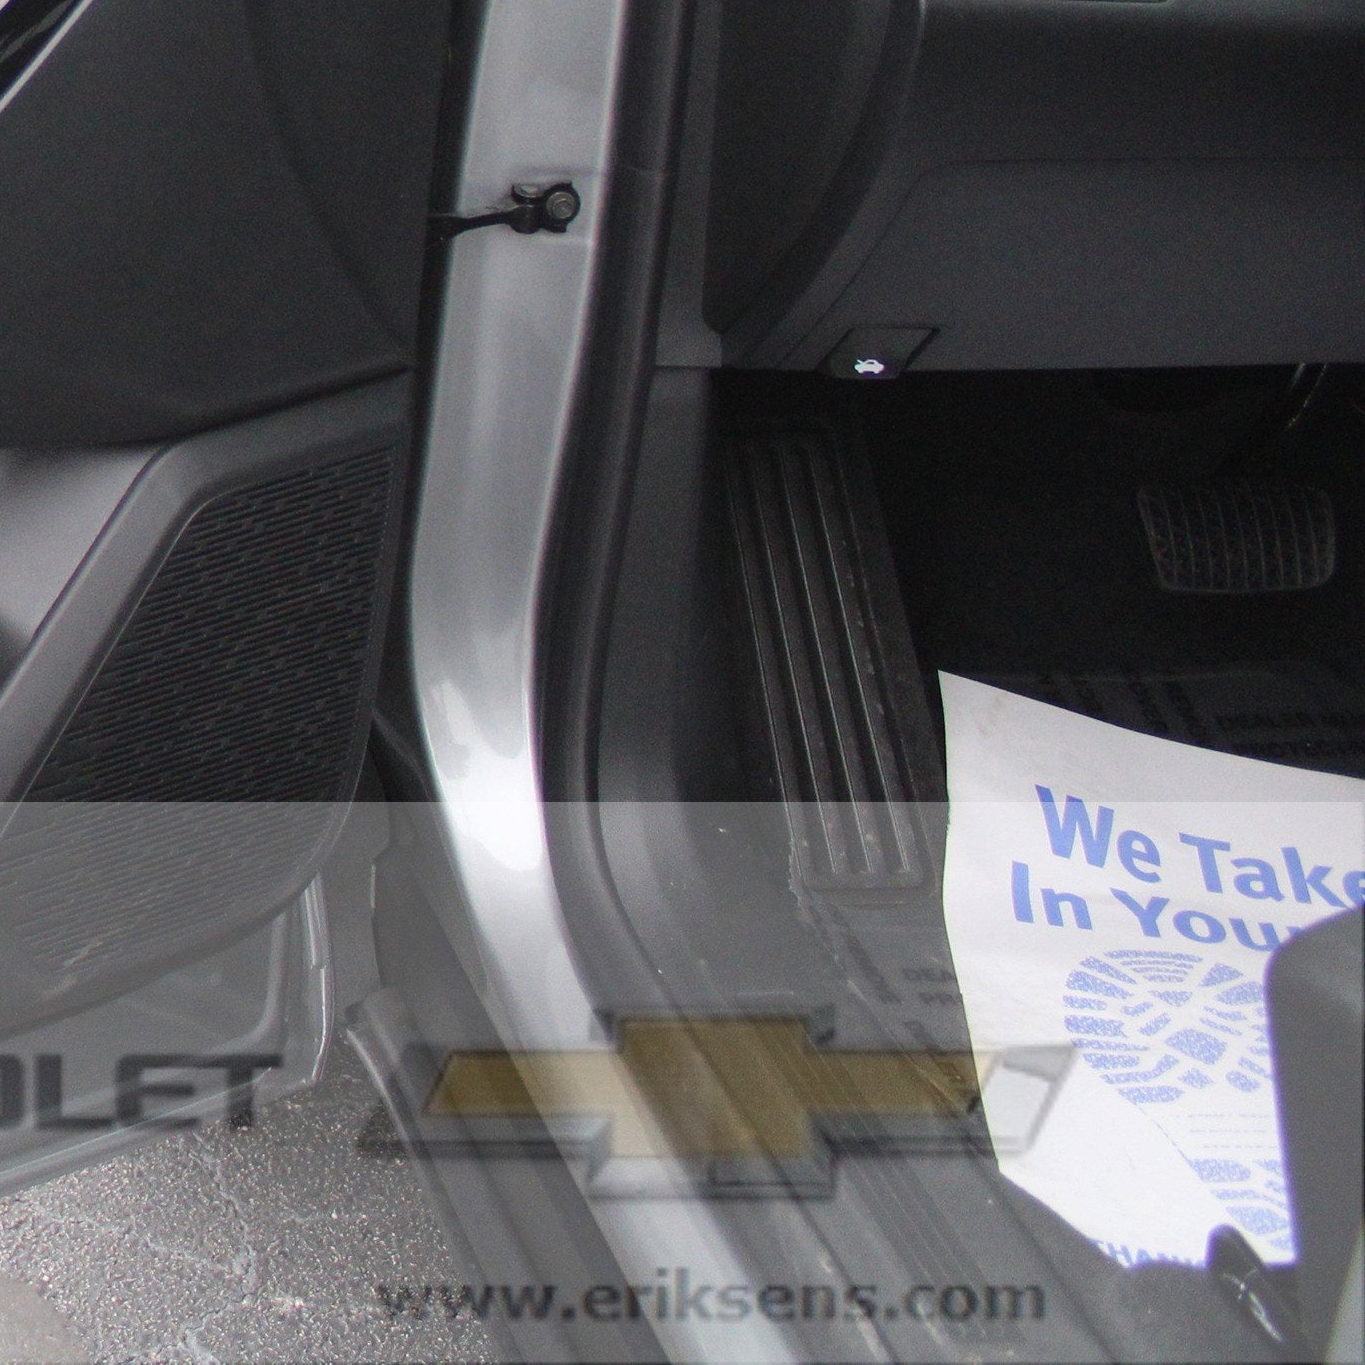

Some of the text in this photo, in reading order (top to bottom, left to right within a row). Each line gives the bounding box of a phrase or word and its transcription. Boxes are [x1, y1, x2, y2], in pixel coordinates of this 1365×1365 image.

[1034, 784, 1162, 884] We
[1011, 860, 1303, 952] In You
